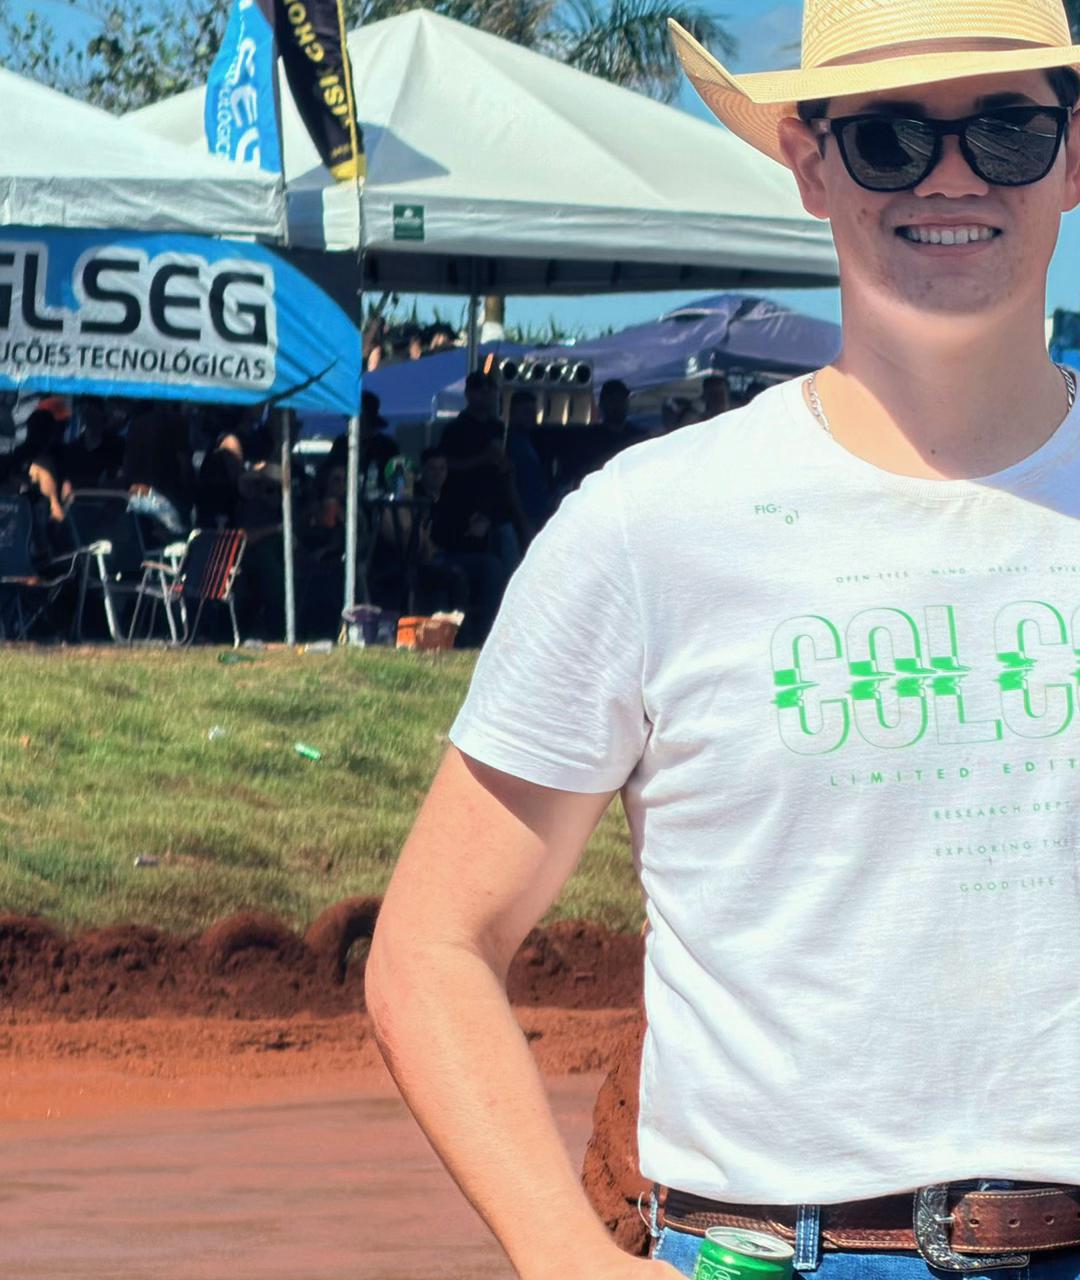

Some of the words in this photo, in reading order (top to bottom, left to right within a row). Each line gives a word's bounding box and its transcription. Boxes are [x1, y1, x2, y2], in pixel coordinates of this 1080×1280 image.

[0, 252, 268, 345] LSEG
[77, 345, 266, 381] TECNOLÓGICAS
[754, 504, 782, 515] FIG:
[835, 574, 870, 584] OPEN
[830, 767, 970, 787] LIMITED
[933, 805, 1022, 820] RESEARCH
[935, 841, 1033, 857] EXPLORING
[1042, 837, 1072, 848] THE
[960, 880, 1010, 893] GOOD
[1021, 876, 1056, 889] LIFE
